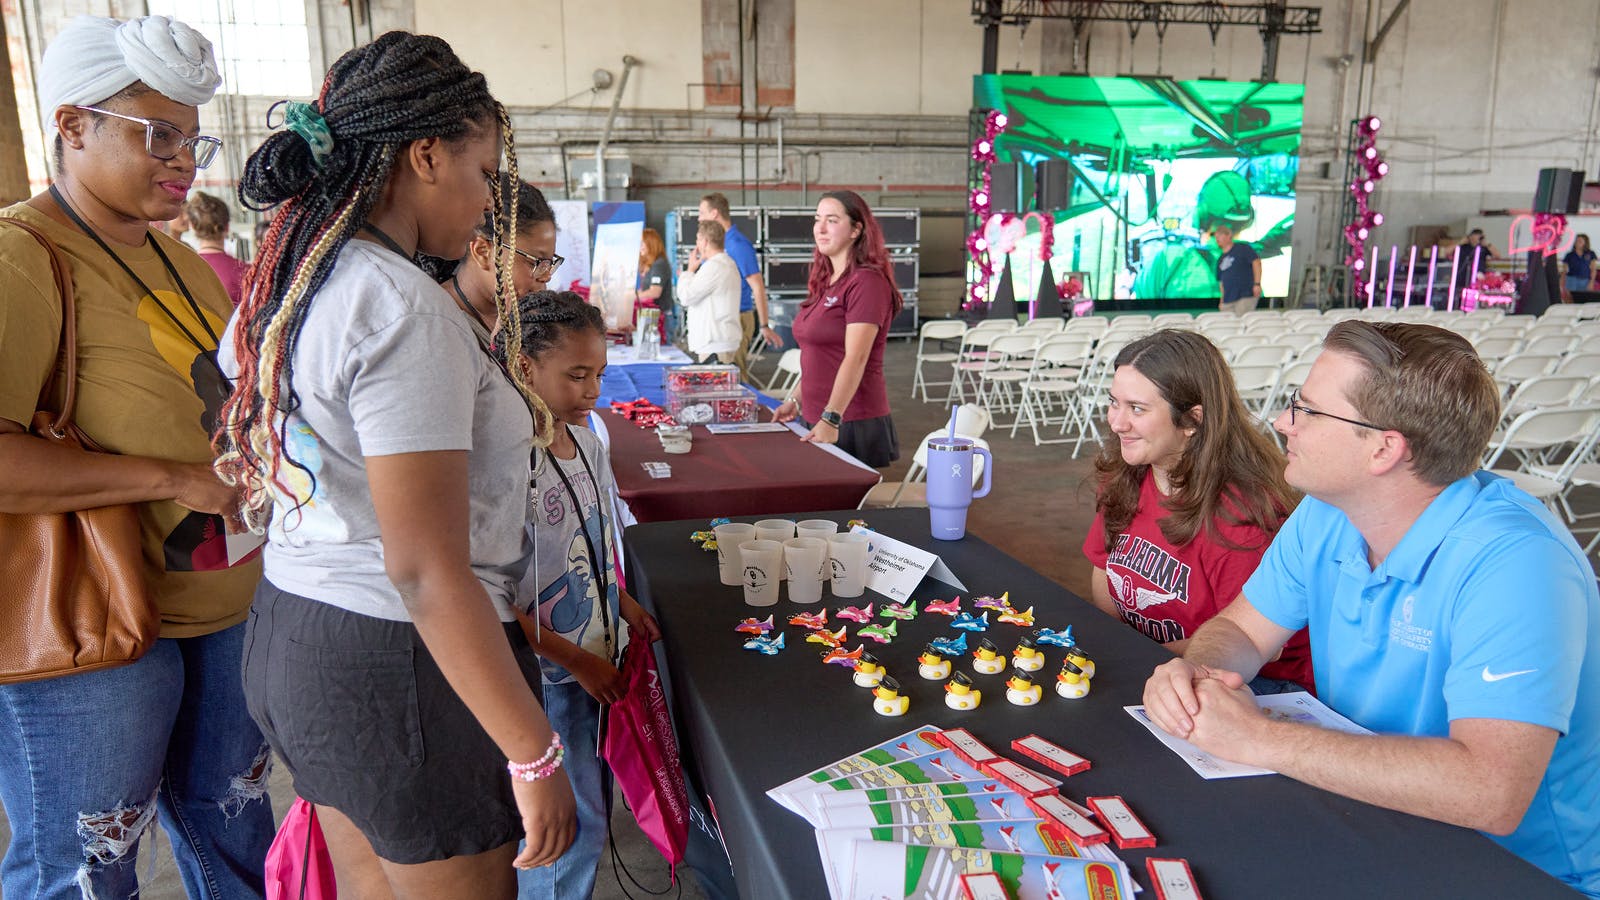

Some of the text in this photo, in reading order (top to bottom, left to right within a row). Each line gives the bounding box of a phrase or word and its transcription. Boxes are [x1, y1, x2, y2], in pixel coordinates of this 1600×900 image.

[868, 562, 888, 574] Airport
[874, 554, 906, 573] Westheimer
[878, 548, 898, 561] University
[903, 557, 925, 571] Oklahoma
